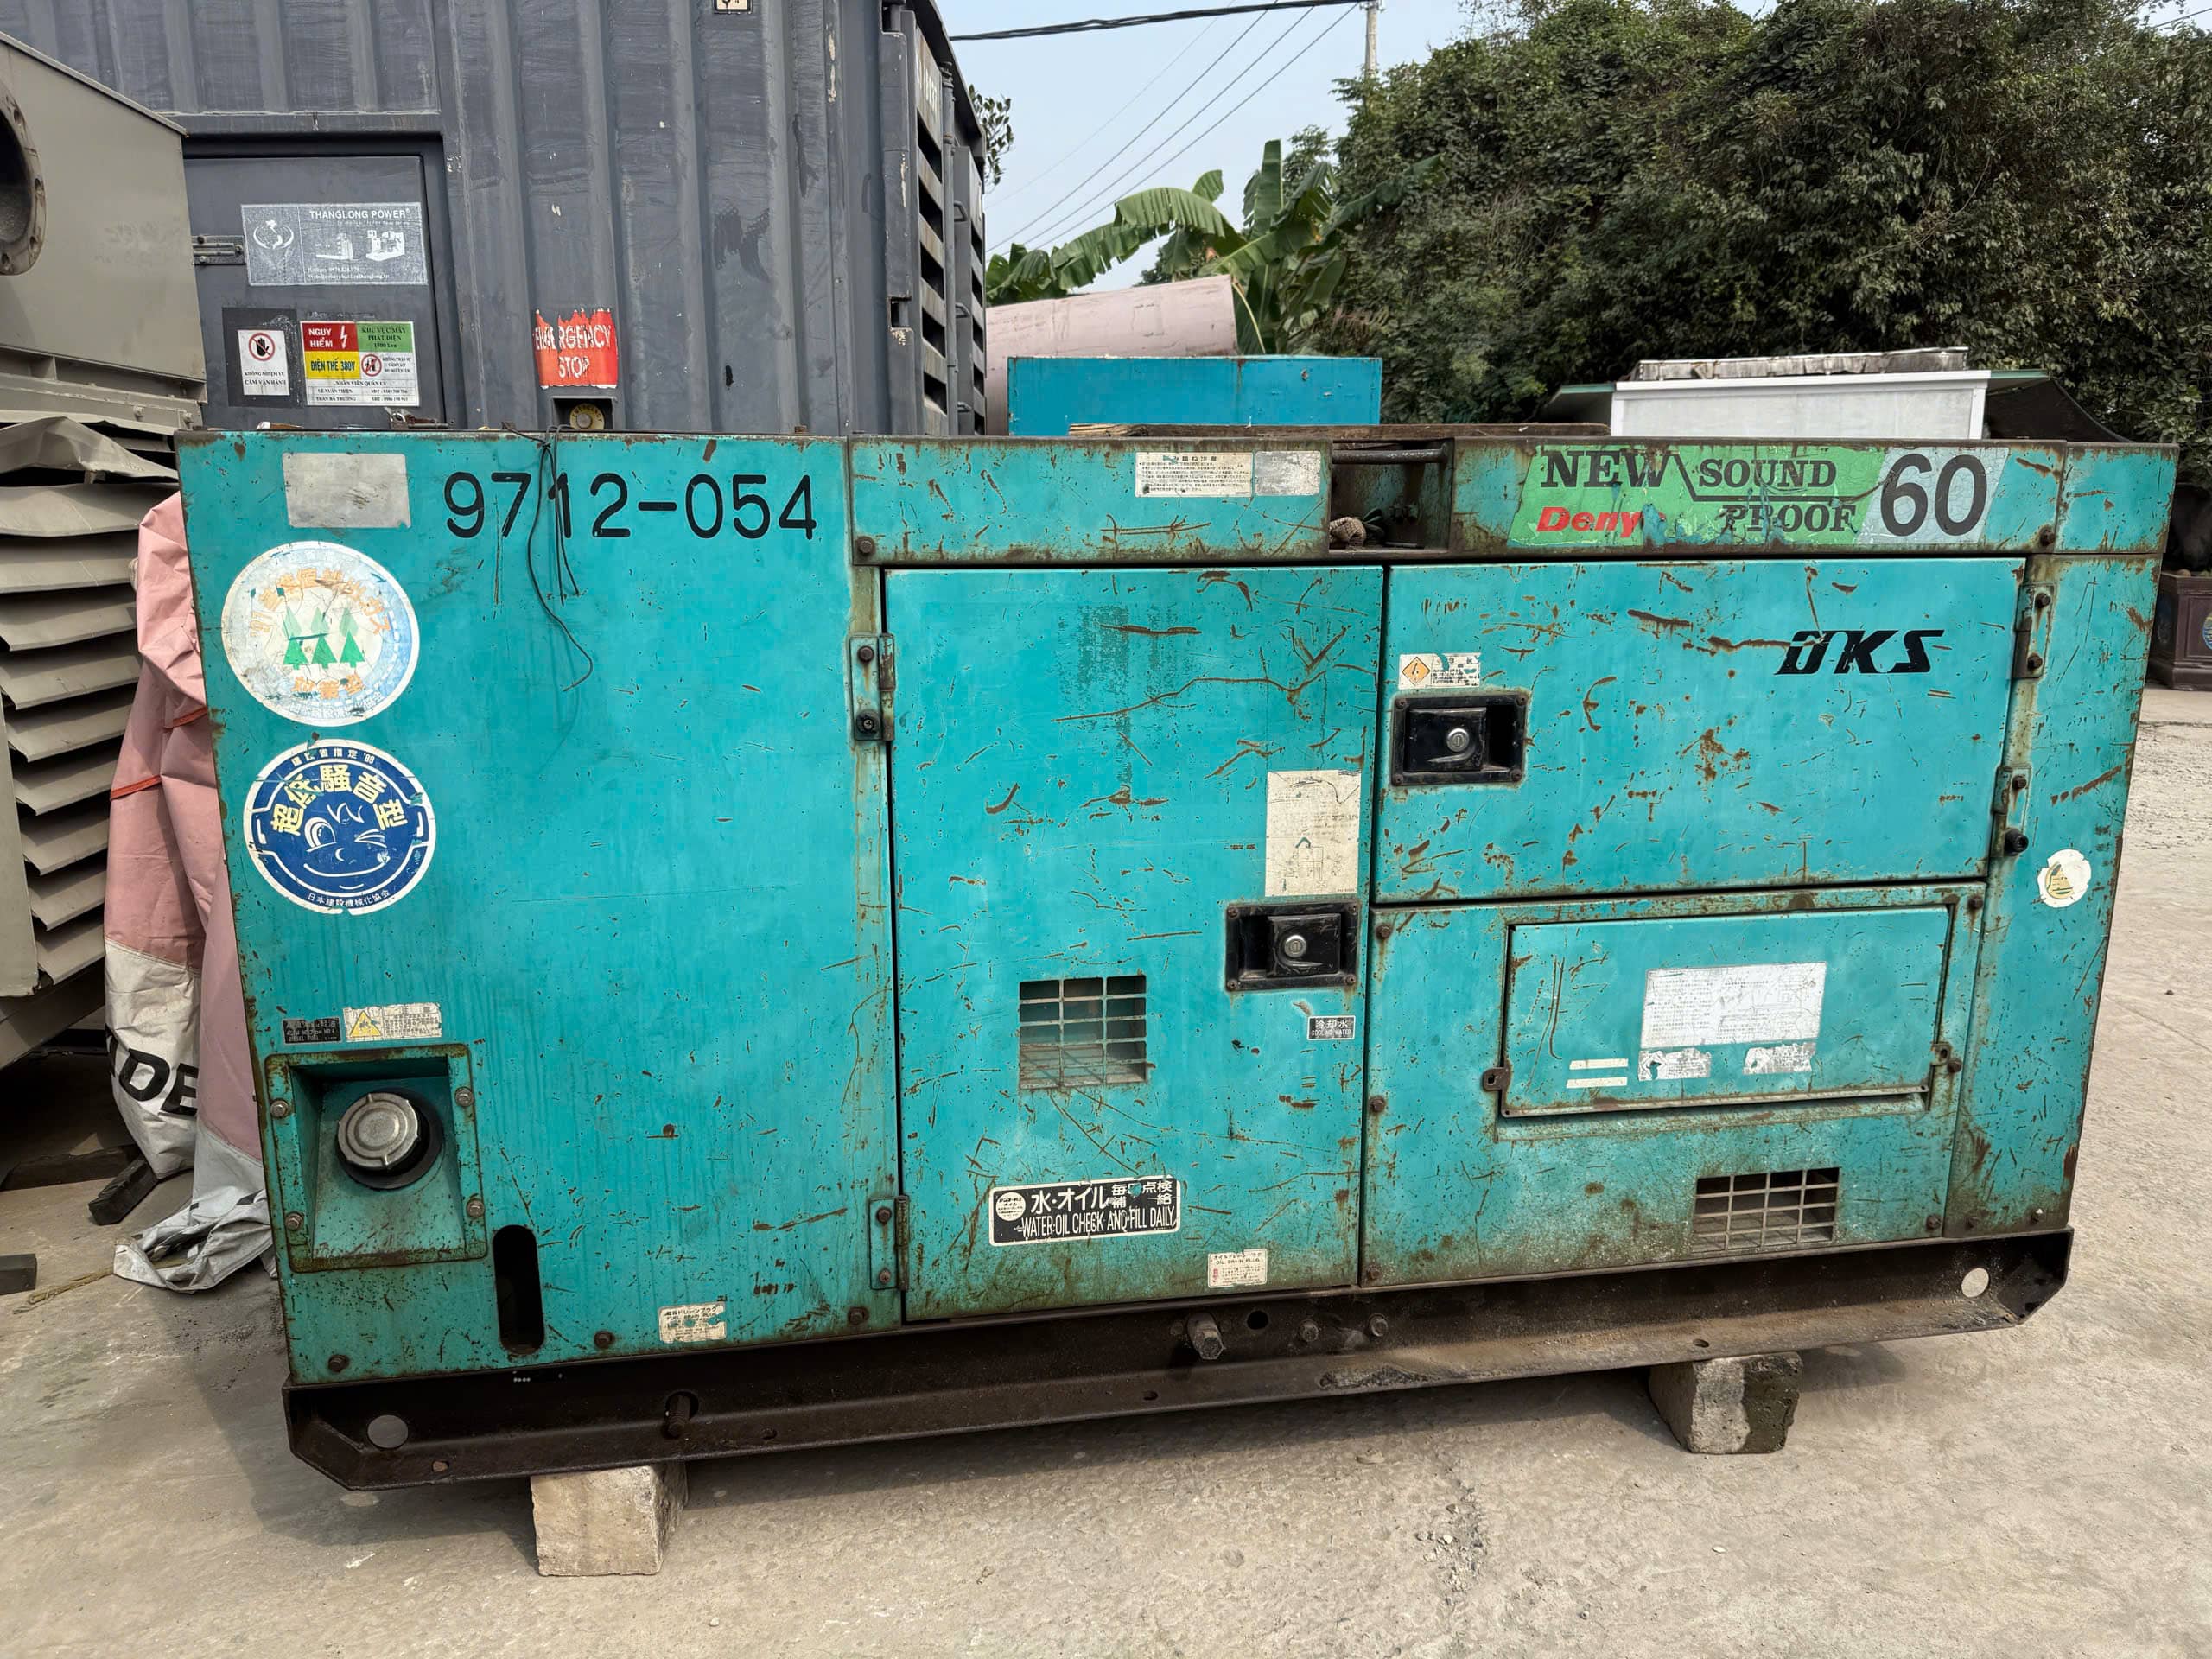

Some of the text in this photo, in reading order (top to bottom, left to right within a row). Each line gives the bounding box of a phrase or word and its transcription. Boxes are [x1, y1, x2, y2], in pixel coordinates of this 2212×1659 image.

[308, 209, 406, 219] THANGLONG POWER
[311, 357, 356, 373] ĐIỆN THẾ 380V
[558, 356, 590, 378] STOP
[1541, 449, 1838, 489] NEW SOUND
[443, 471, 817, 540] 9712-054
[1879, 453, 1987, 537] 60
[1536, 506, 1667, 538] Deny
[1719, 504, 1858, 533] PROOF
[1072, 1210, 1103, 1234] CHECK
[1150, 1205, 1175, 1228] DAILY
